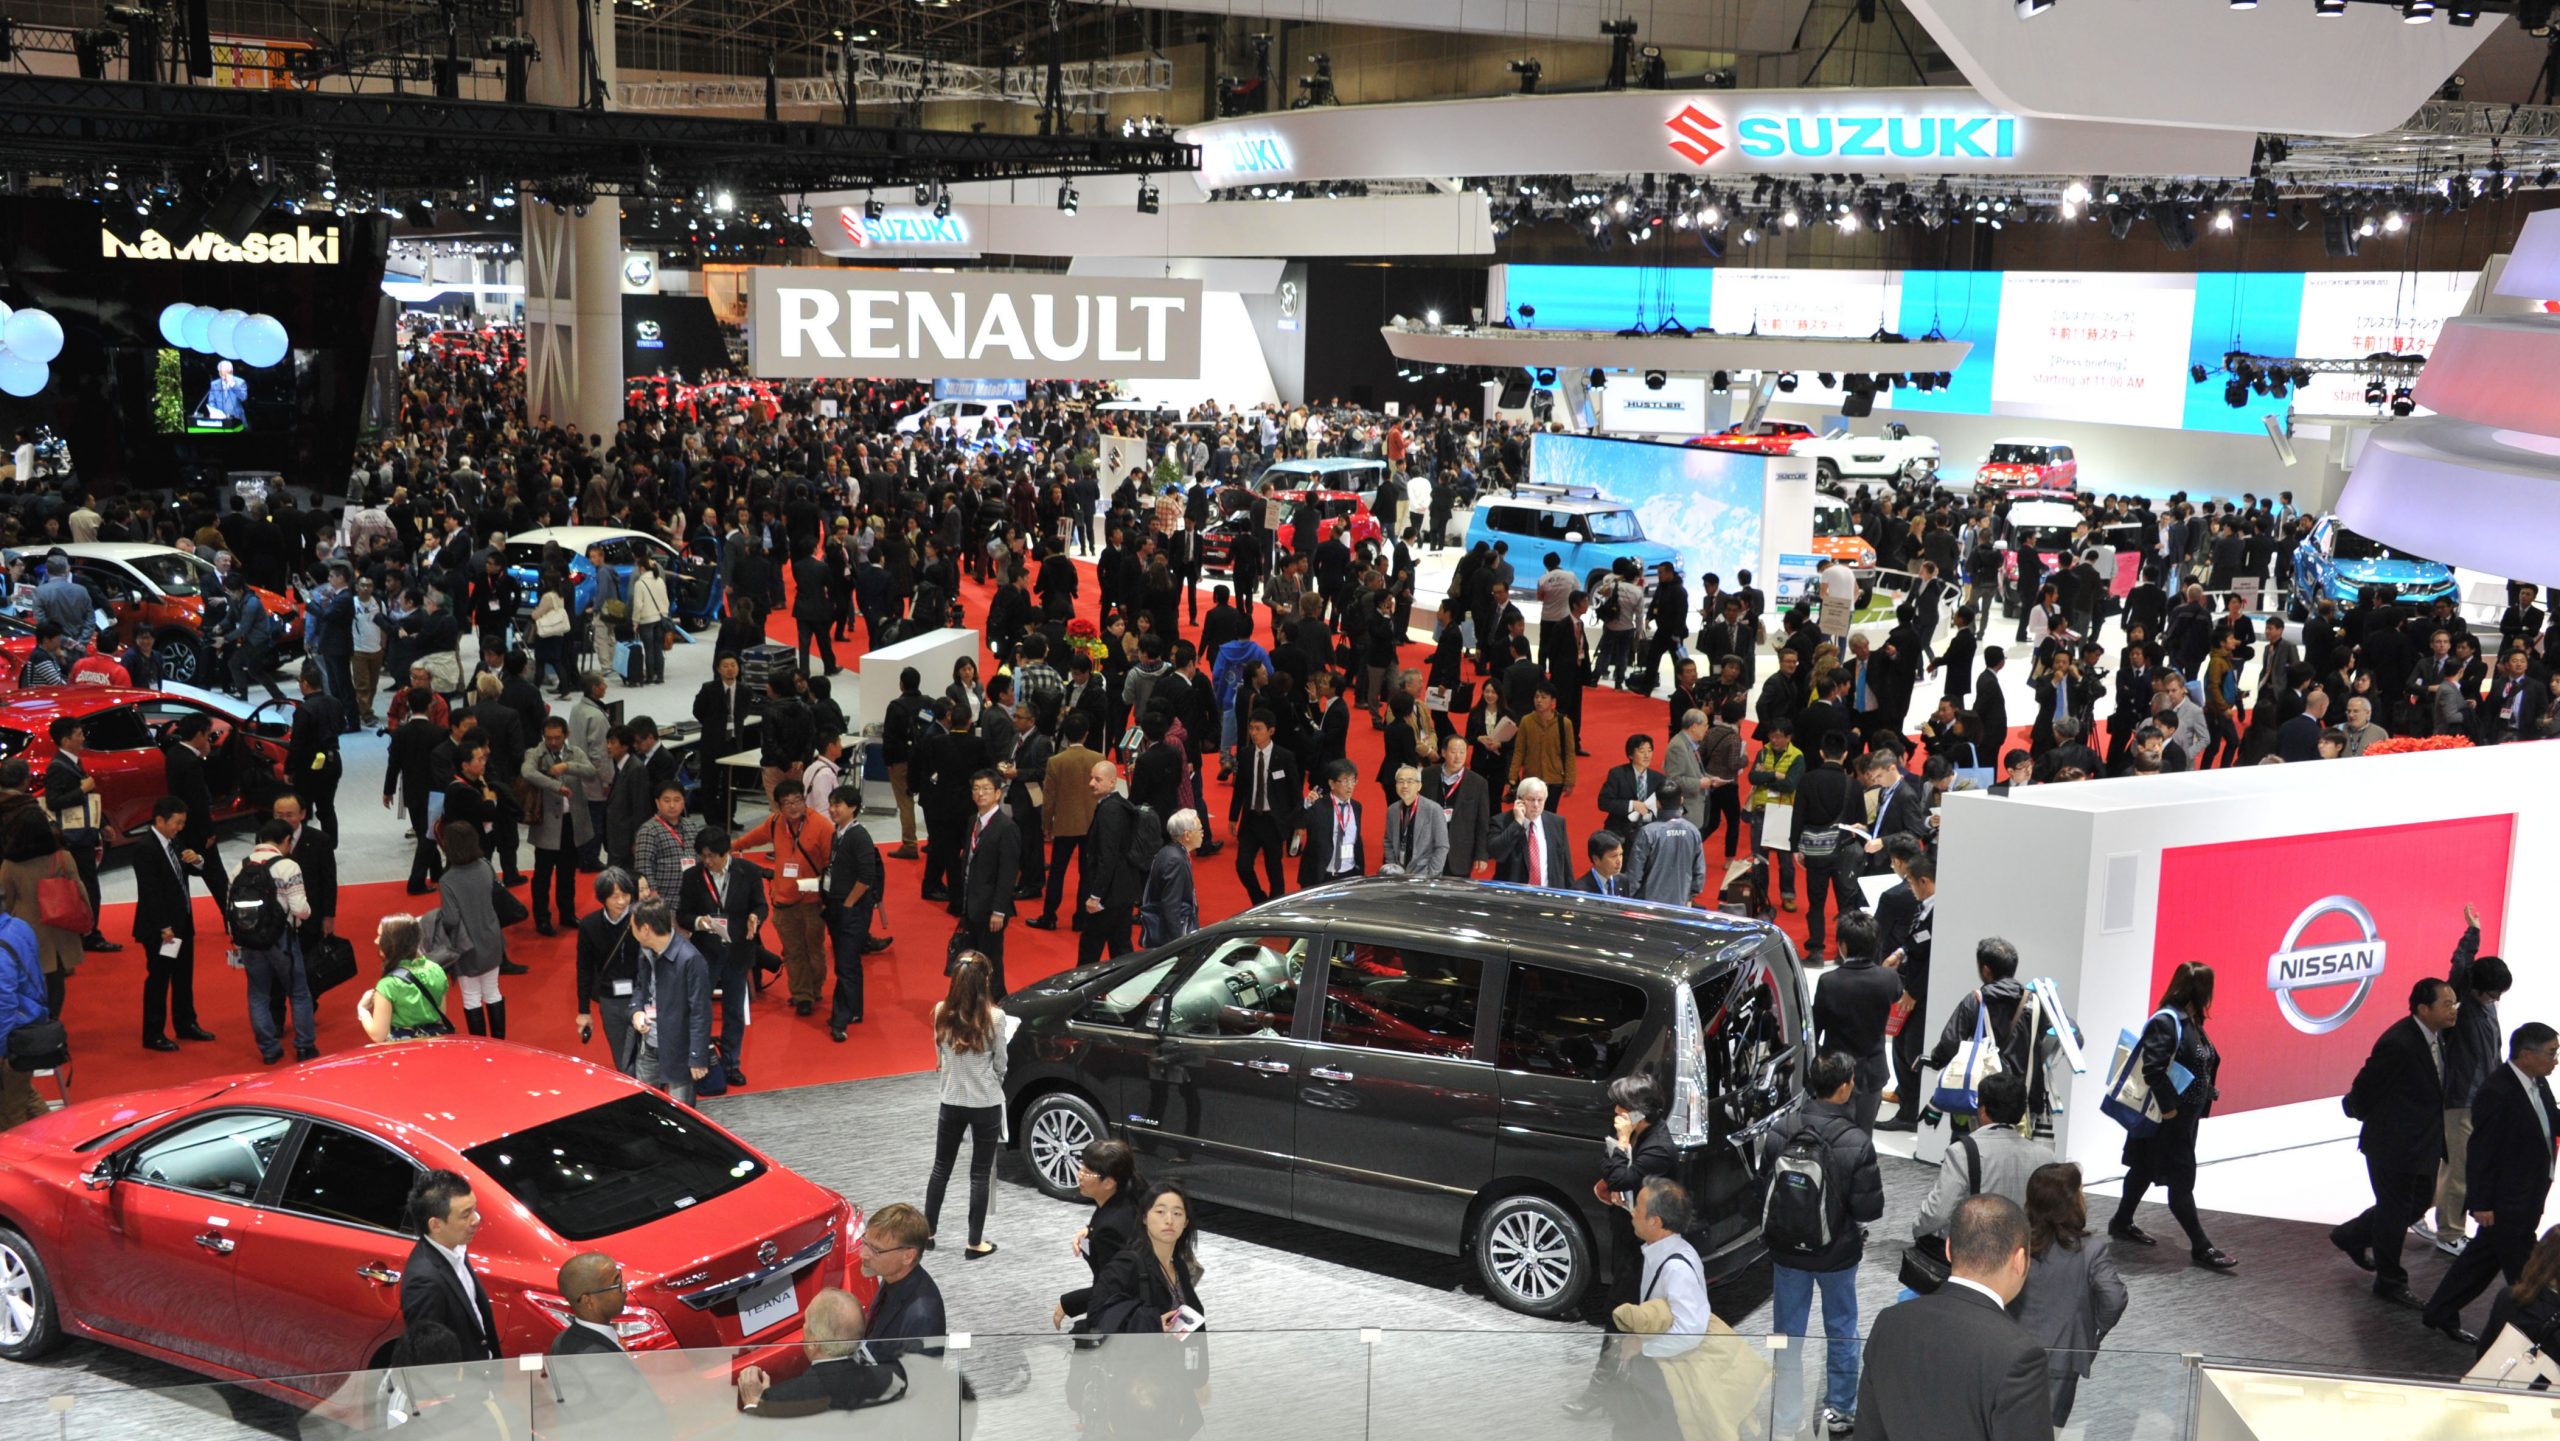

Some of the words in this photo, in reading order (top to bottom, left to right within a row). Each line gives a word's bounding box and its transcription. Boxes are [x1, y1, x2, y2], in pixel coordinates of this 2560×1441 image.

[1738, 117, 2014, 157] SUZUKI
[863, 218, 963, 242] SUZUKI
[777, 288, 1185, 362] RENAULT
[2351, 335, 2436, 353] 午前11時スター
[2033, 374, 2075, 387] starting
[2127, 377, 2145, 389] AM
[1627, 401, 1682, 409] HUSTLER
[2280, 949, 2374, 981] NISSAN
[744, 1291, 792, 1317] TEANA
